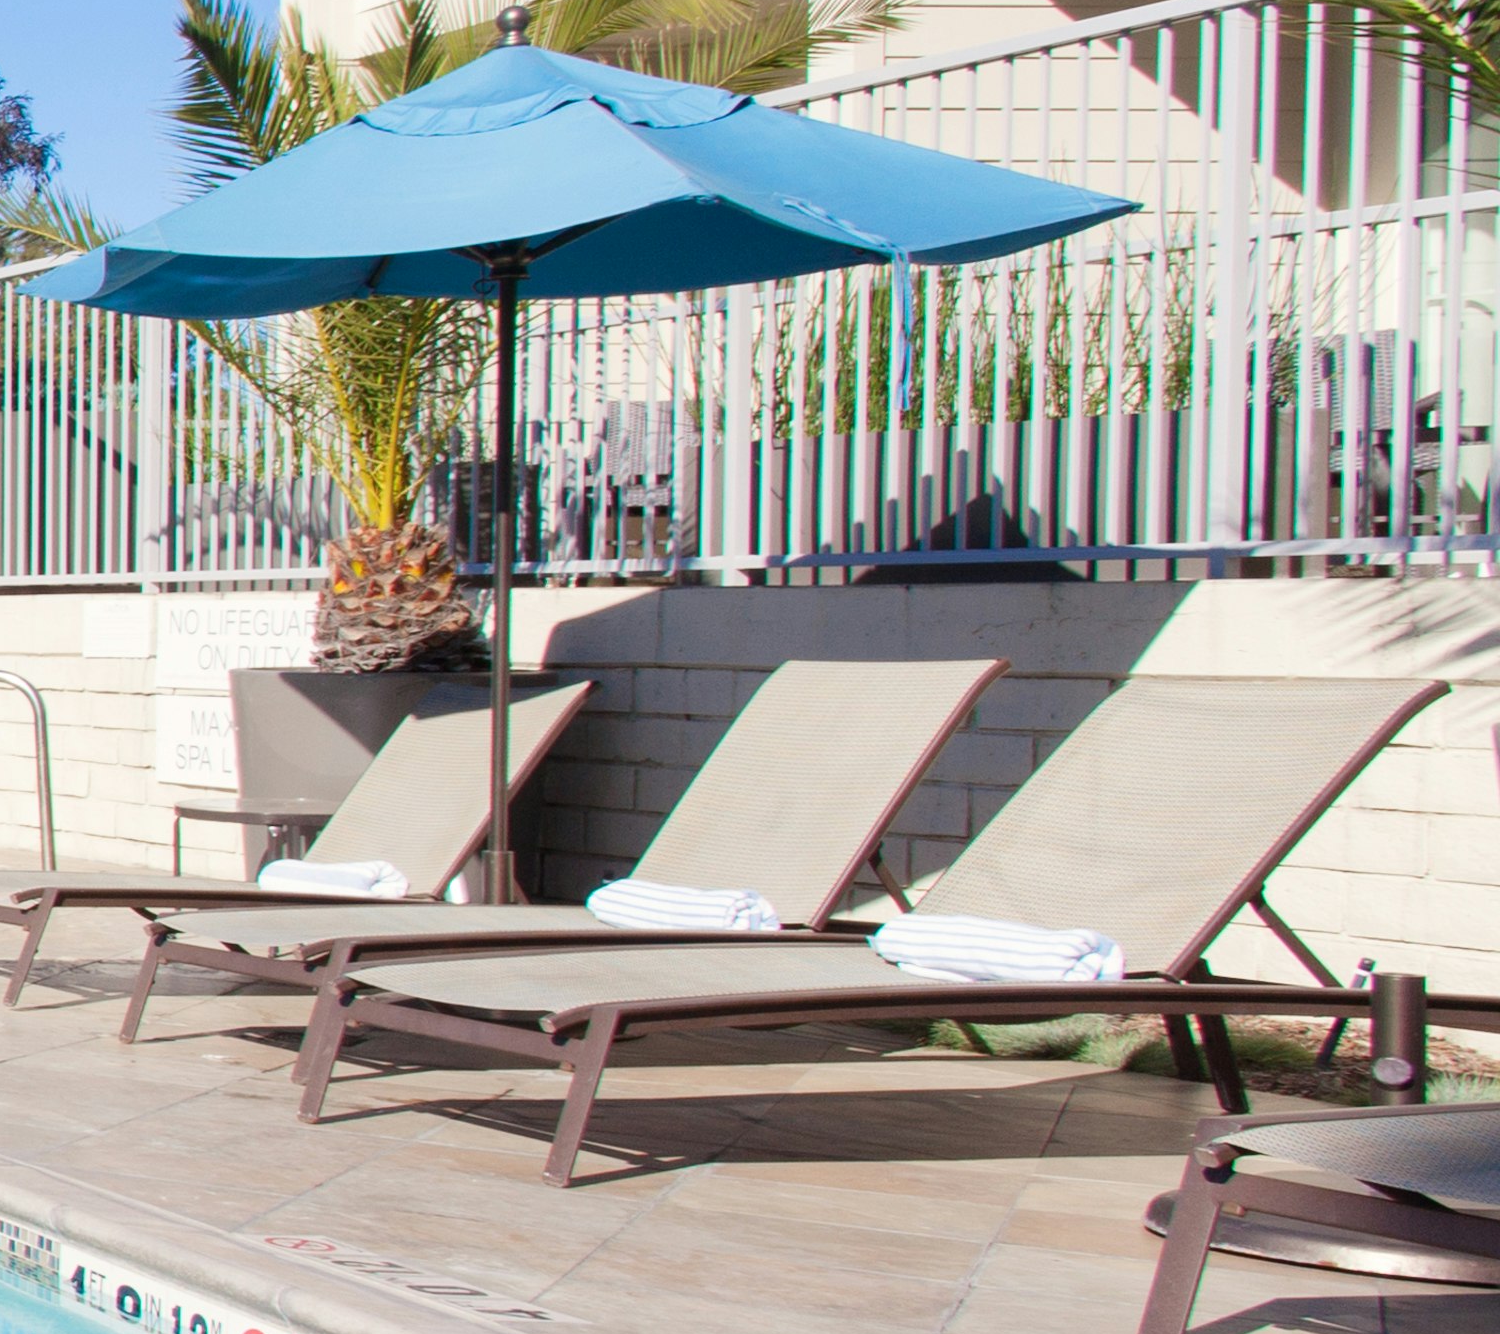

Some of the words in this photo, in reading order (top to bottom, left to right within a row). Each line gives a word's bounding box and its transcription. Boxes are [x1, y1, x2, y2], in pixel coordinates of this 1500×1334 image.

[169, 609, 201, 636] NO
[206, 609, 316, 637] LIFEGUAR
[198, 643, 228, 671] ON
[237, 645, 301, 667] DUTY
[176, 744, 213, 772] SPA
[70, 1264, 85, 1296] 4
[144, 1292, 162, 1318] IN
